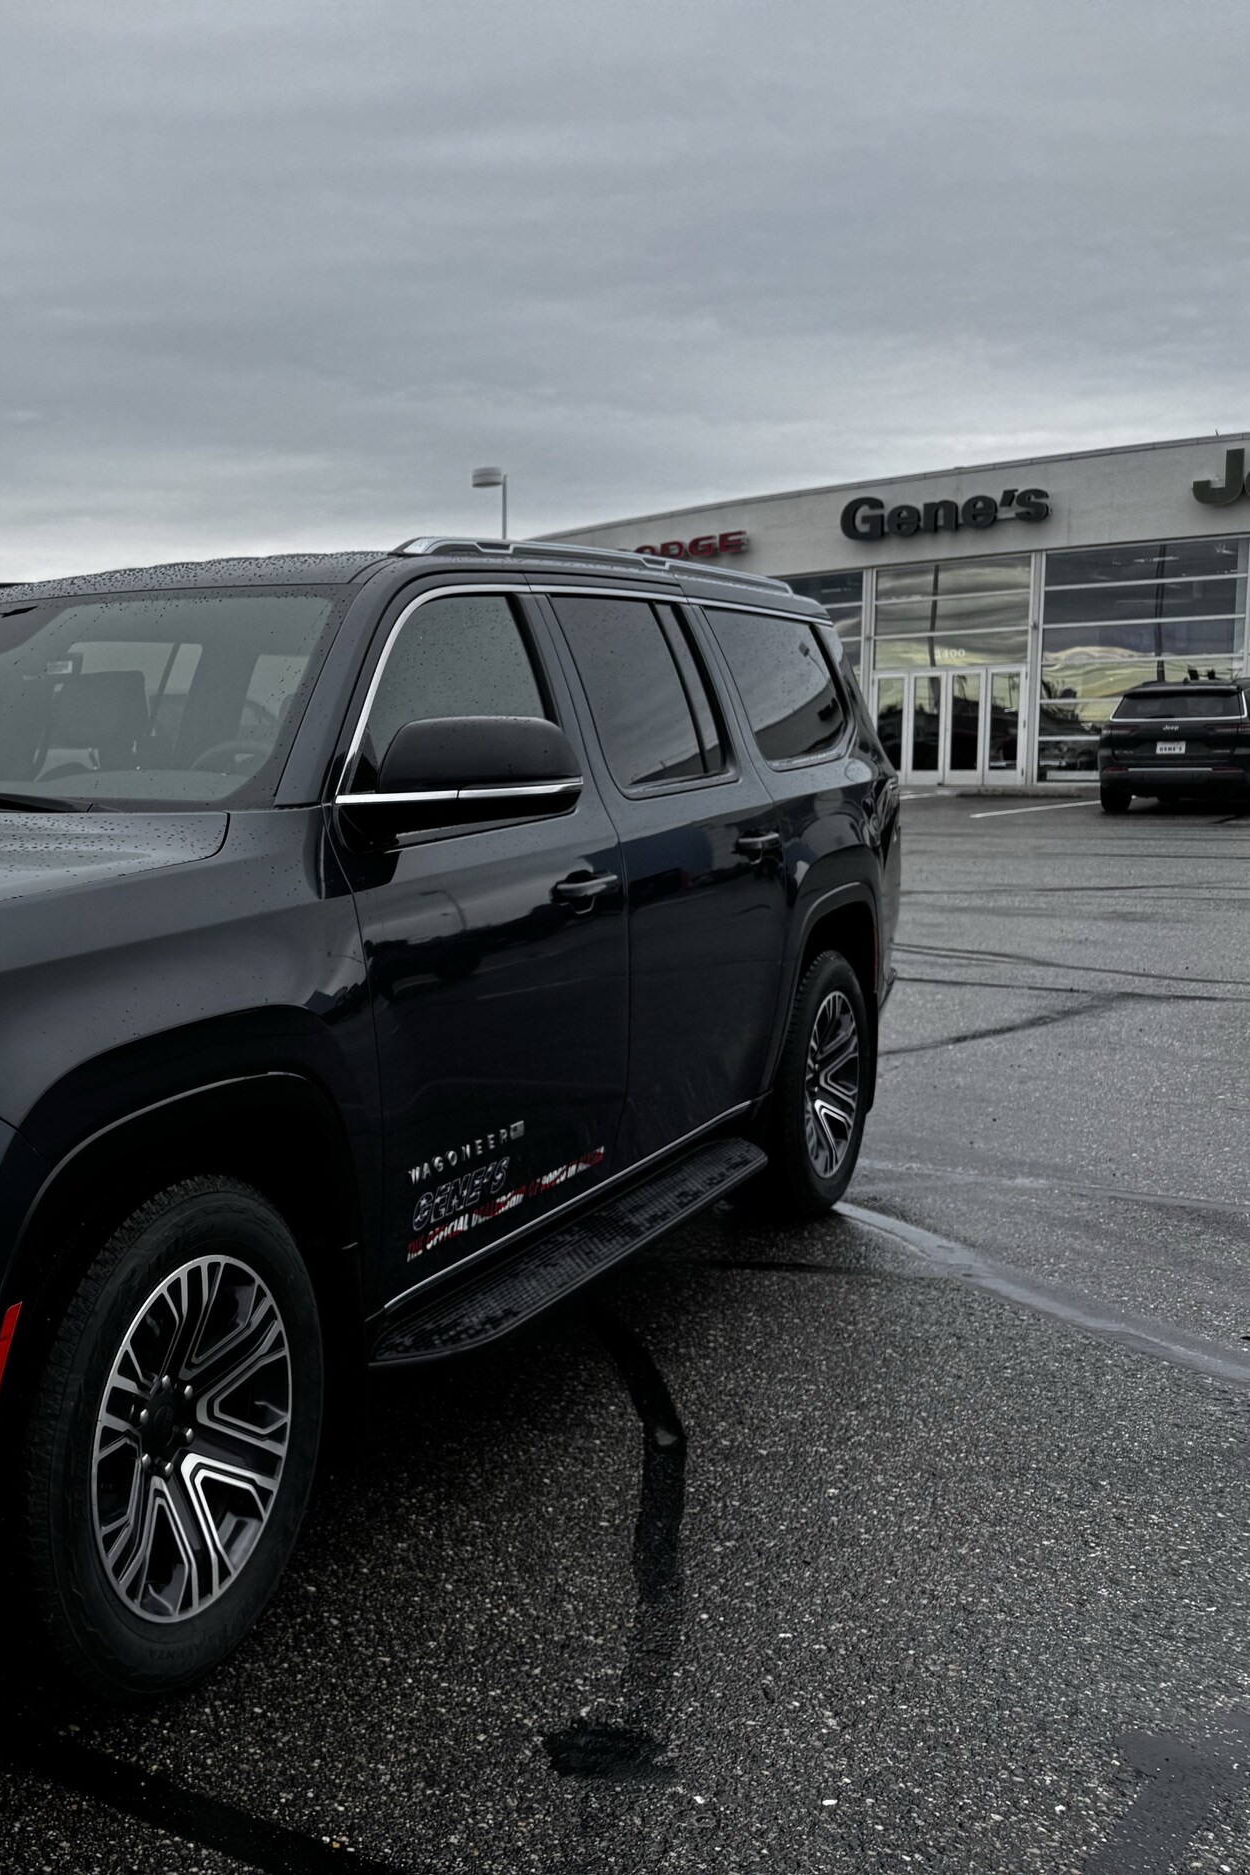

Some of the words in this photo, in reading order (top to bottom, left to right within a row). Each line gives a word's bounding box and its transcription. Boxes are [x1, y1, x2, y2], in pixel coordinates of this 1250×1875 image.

[1192, 448, 1250, 506] J
[840, 488, 1052, 541] Gene's
[408, 1128, 508, 1185] WAGONEER
[412, 1156, 510, 1231] GENE'S
[426, 1213, 469, 1250] OFFICIAL
